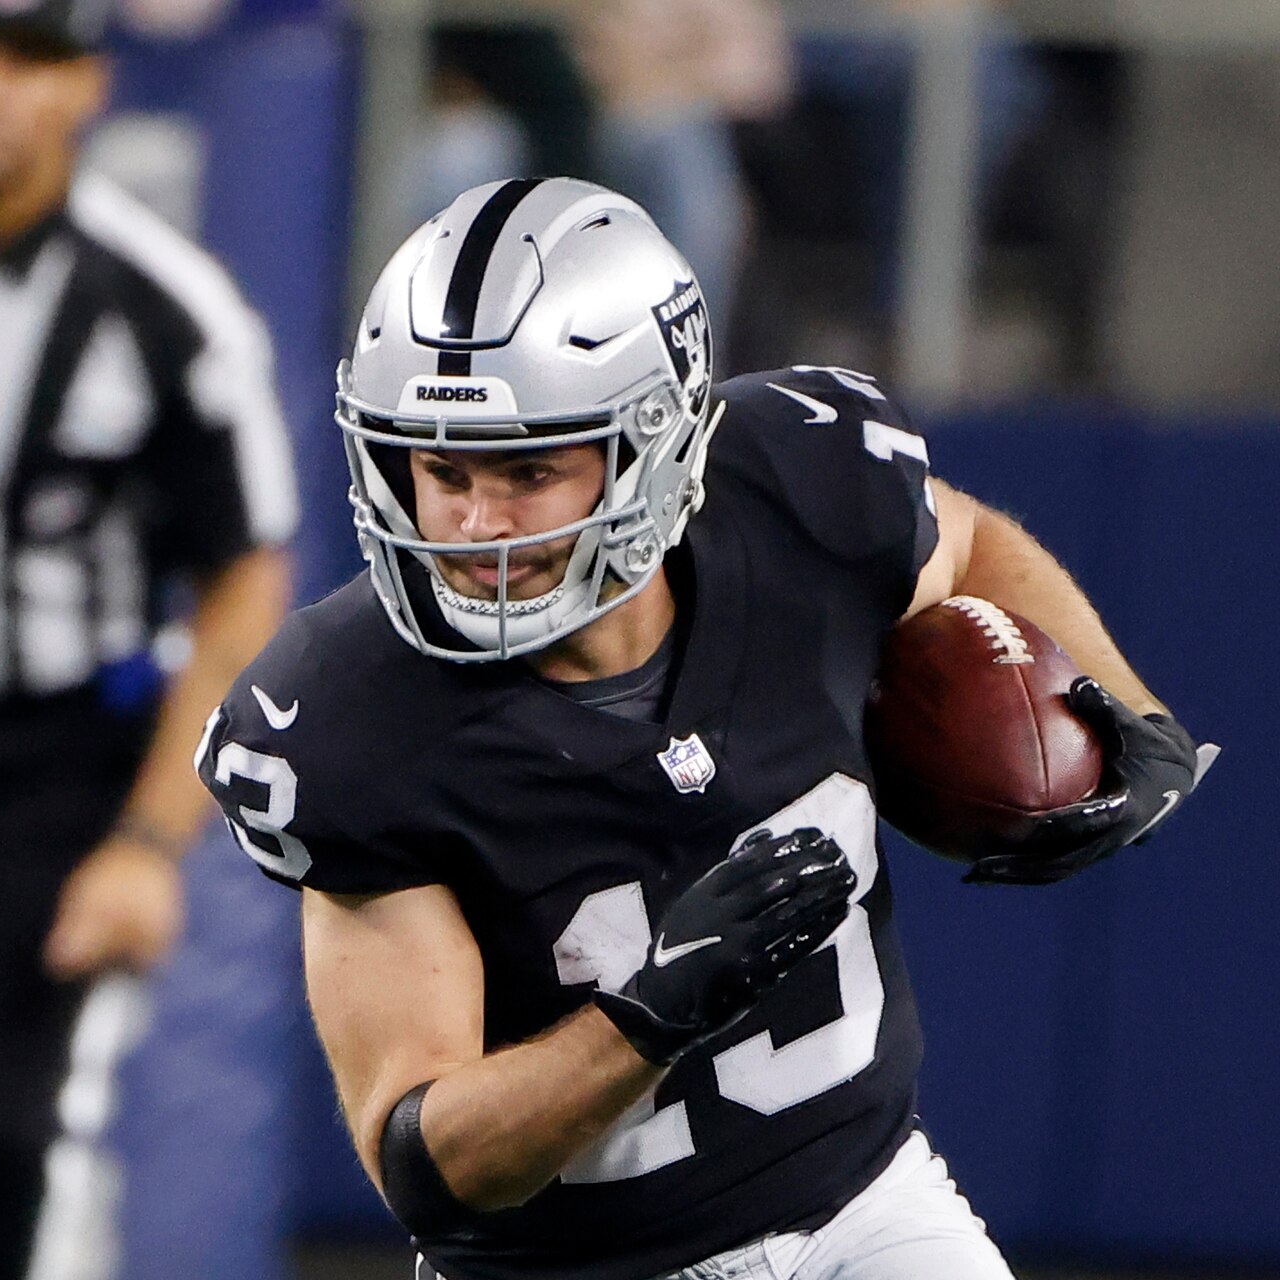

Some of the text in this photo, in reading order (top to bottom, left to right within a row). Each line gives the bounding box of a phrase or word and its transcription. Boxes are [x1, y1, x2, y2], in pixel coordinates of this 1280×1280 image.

[416, 385, 488, 402] RAIDERS
[676, 758, 708, 786] NFL
[553, 771, 886, 1185] 13
